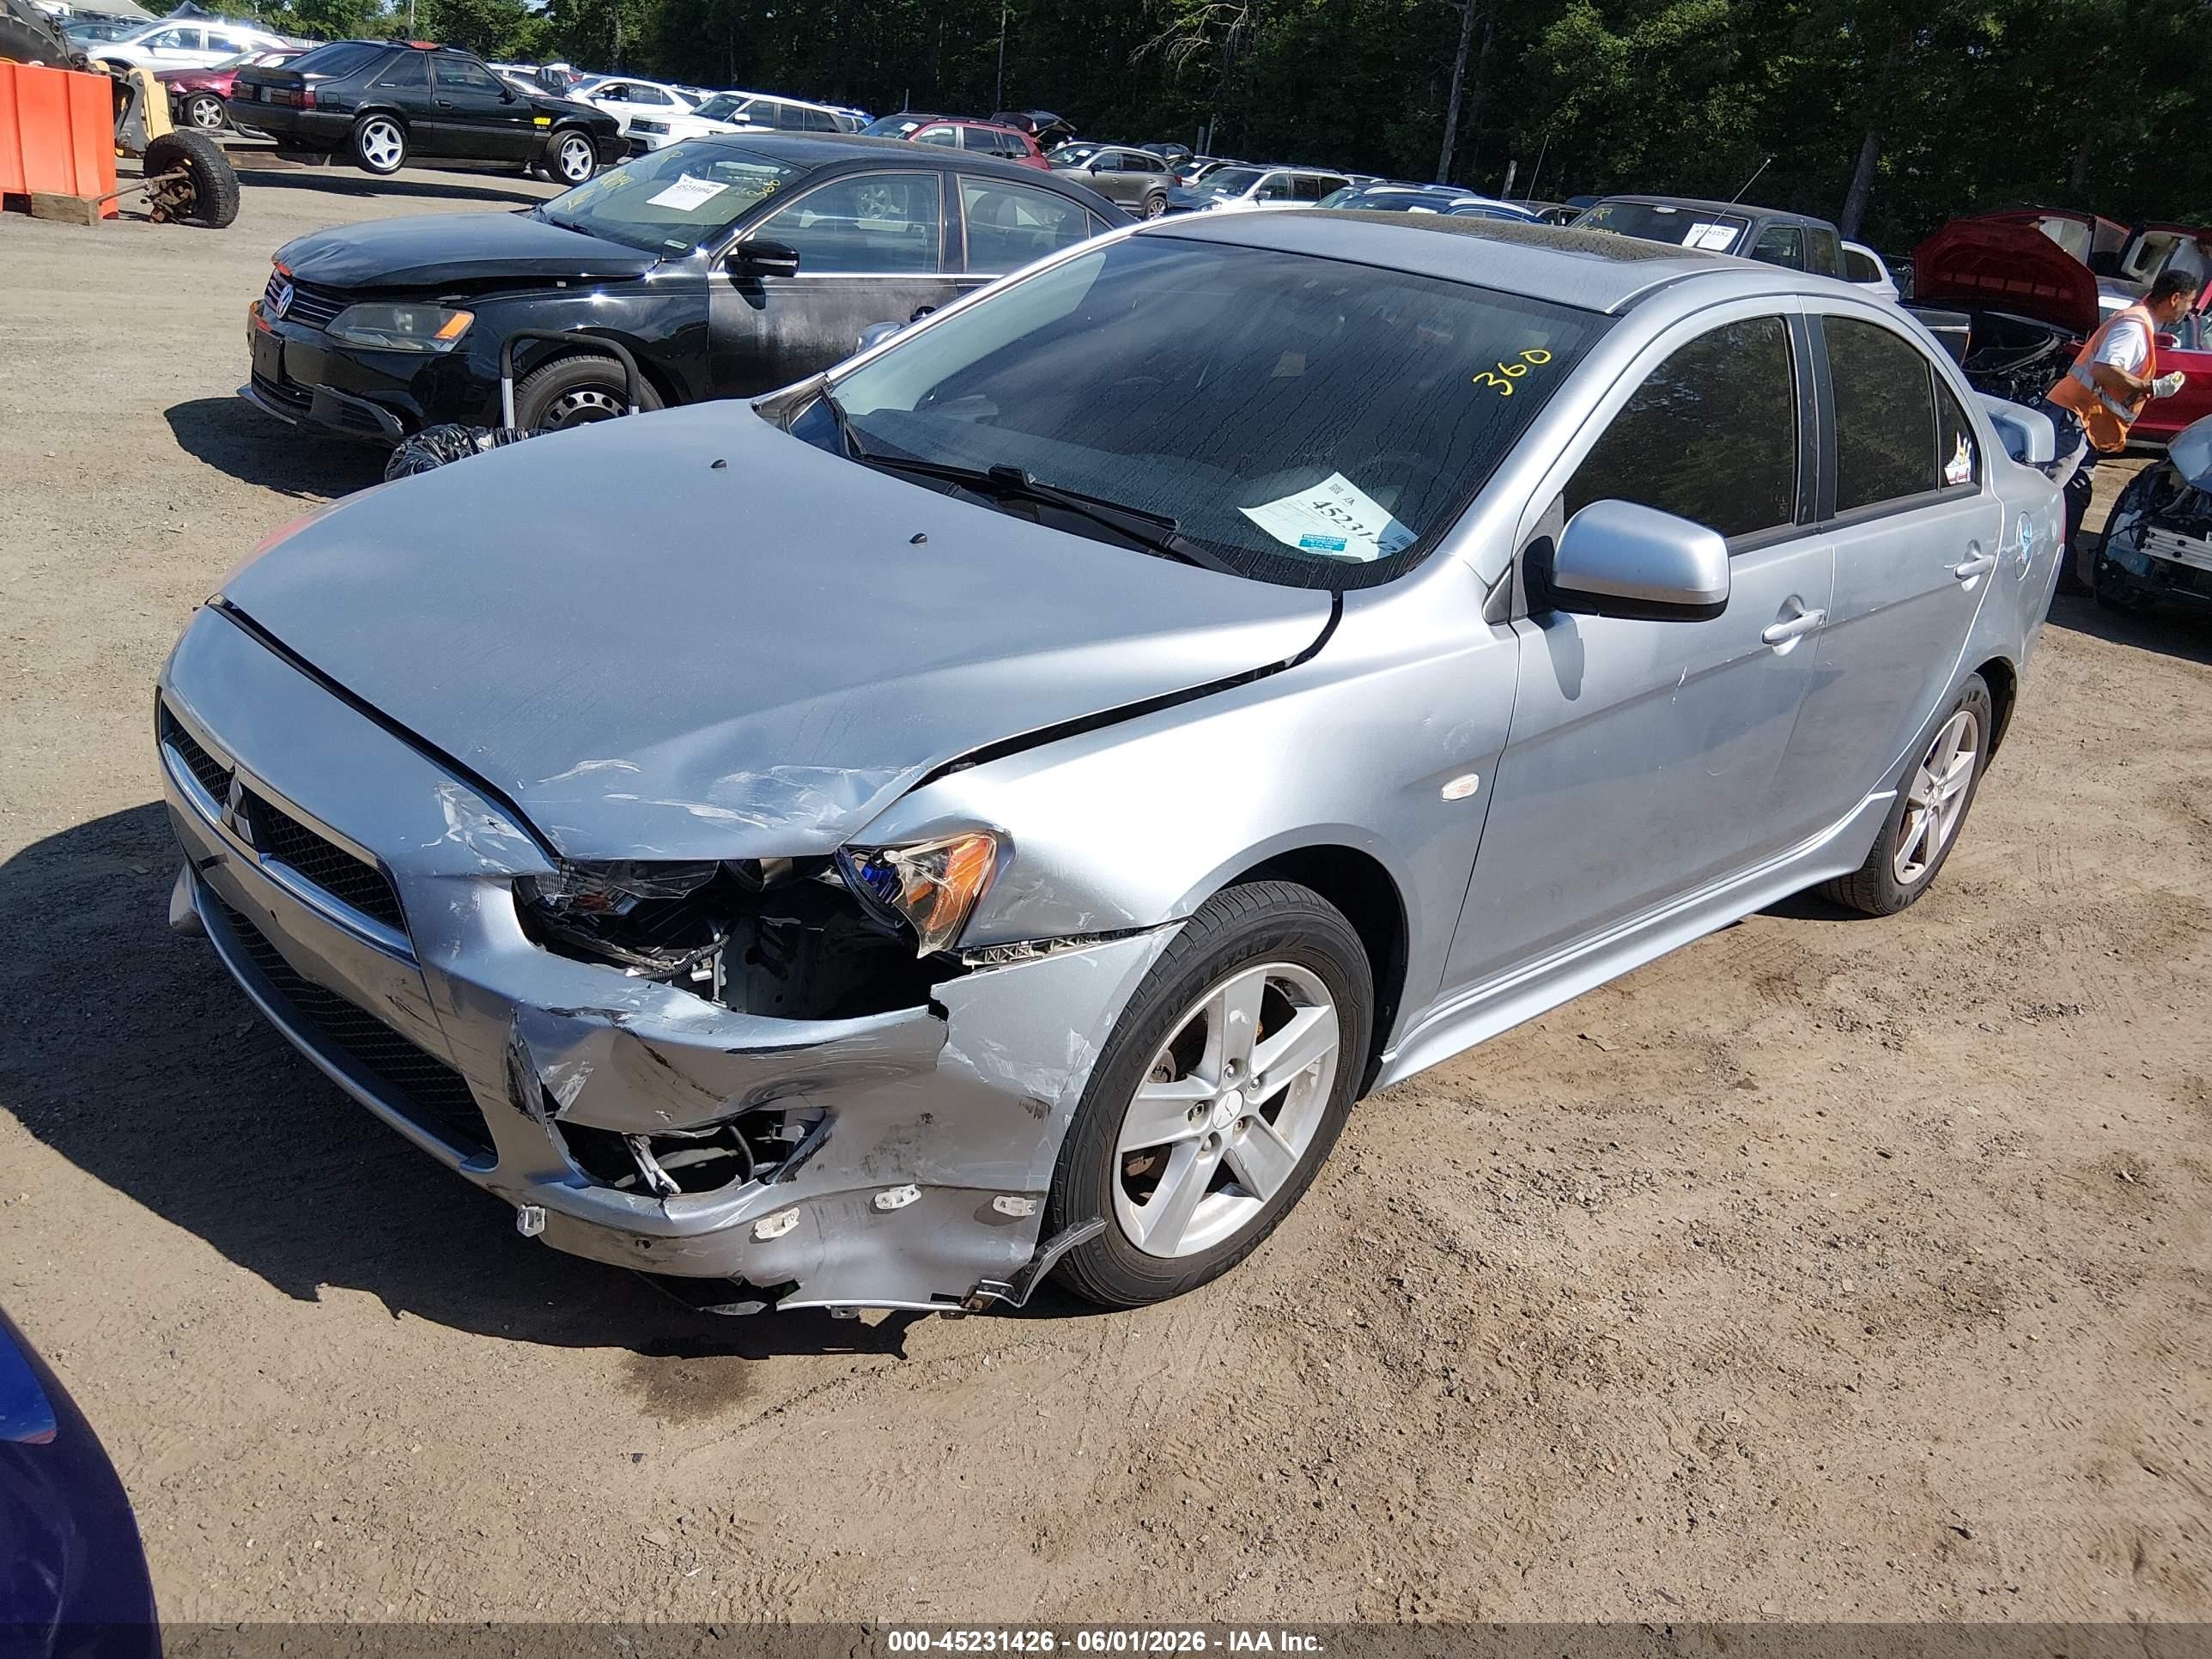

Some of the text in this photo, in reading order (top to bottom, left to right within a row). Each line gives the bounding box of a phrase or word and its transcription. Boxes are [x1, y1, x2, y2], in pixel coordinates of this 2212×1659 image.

[747, 179, 781, 198] 360
[1472, 349, 1553, 397] 360
[1312, 501, 1398, 555] 4523142
